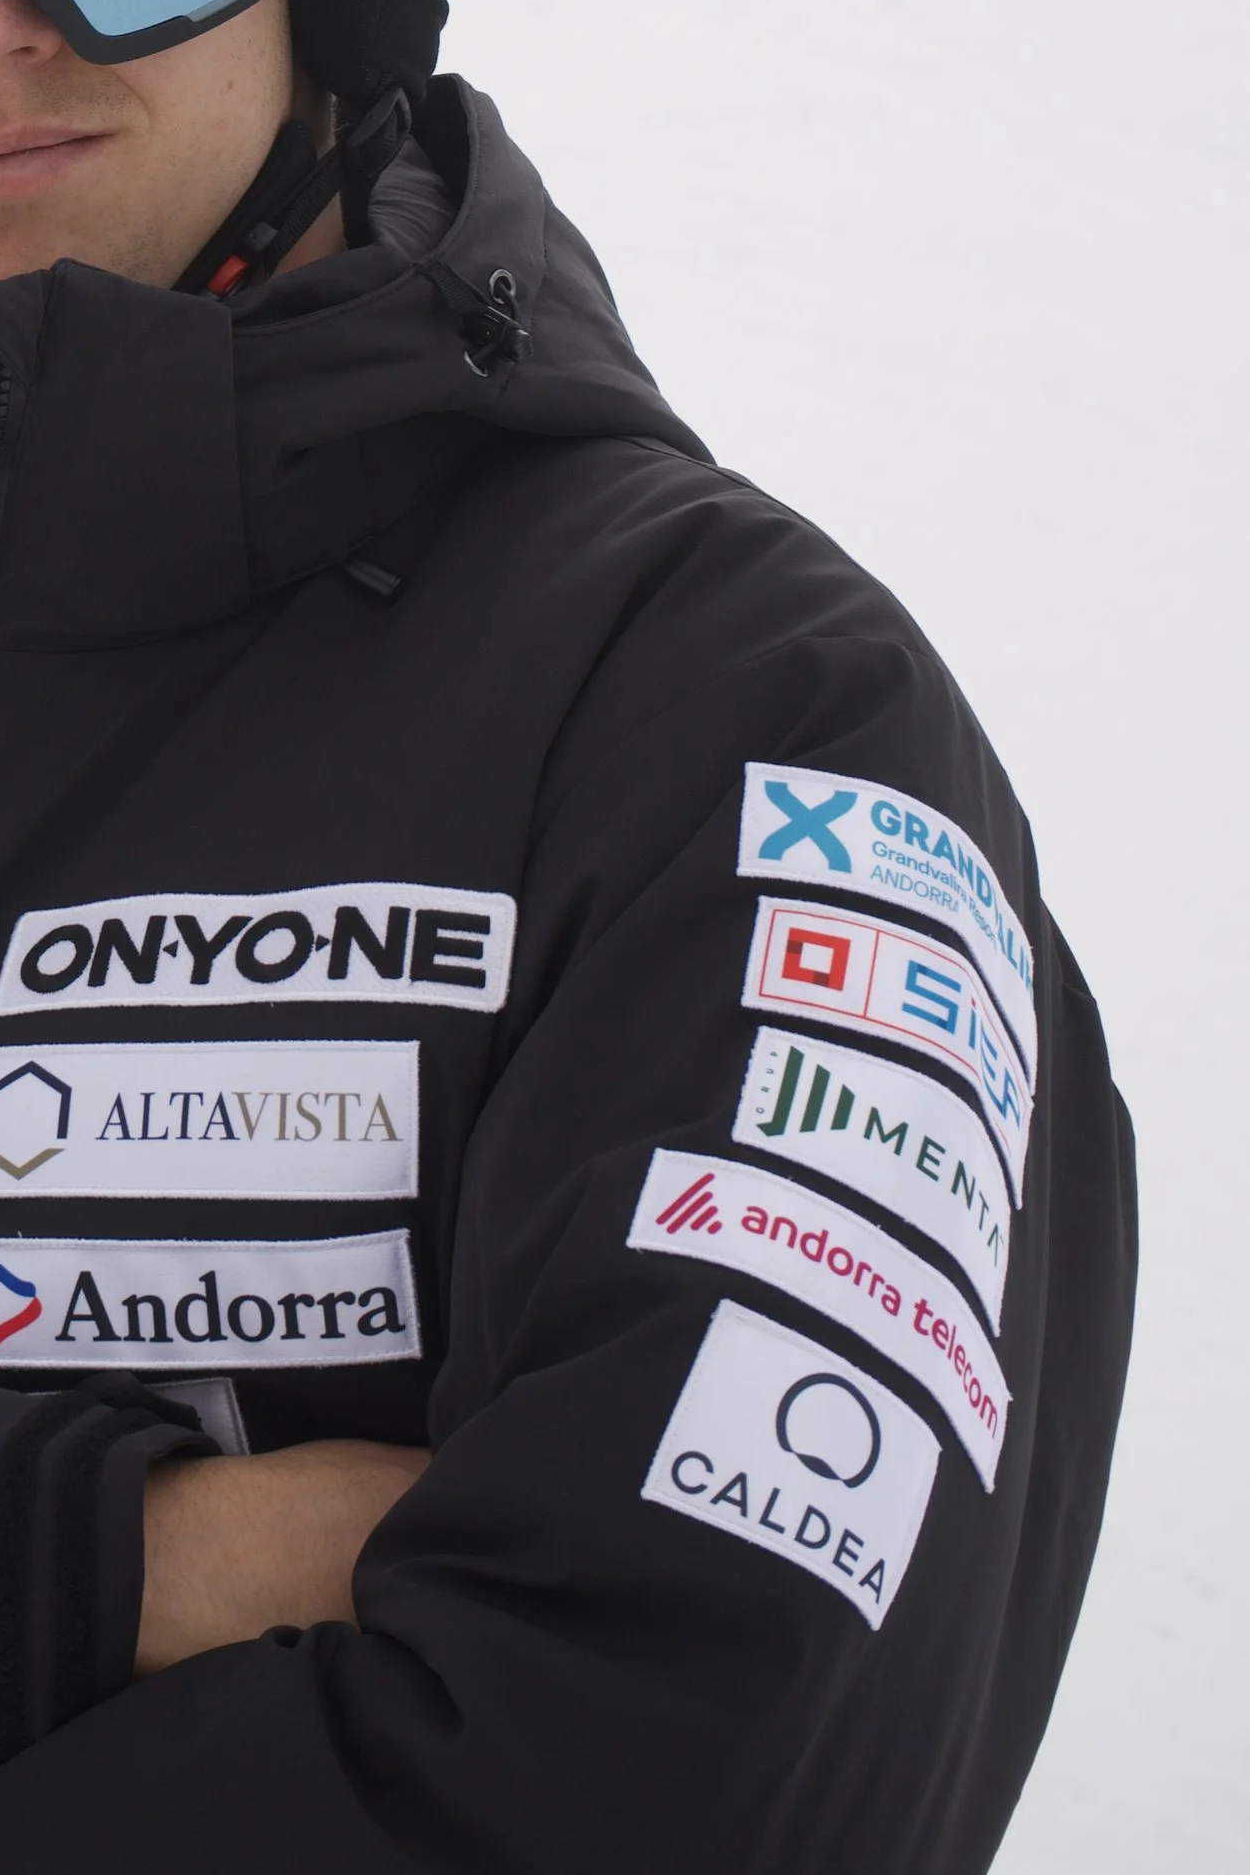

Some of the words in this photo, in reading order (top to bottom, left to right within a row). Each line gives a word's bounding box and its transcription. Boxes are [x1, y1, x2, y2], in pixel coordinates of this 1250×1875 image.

[870, 864, 960, 913] ANDORRA
[95, 1091, 403, 1143] ALTAVISTA
[55, 1270, 405, 1344] Andorra
[741, 1204, 902, 1317] andorra
[913, 1297, 1000, 1442] telecom
[670, 1450, 886, 1605] CALDEA
